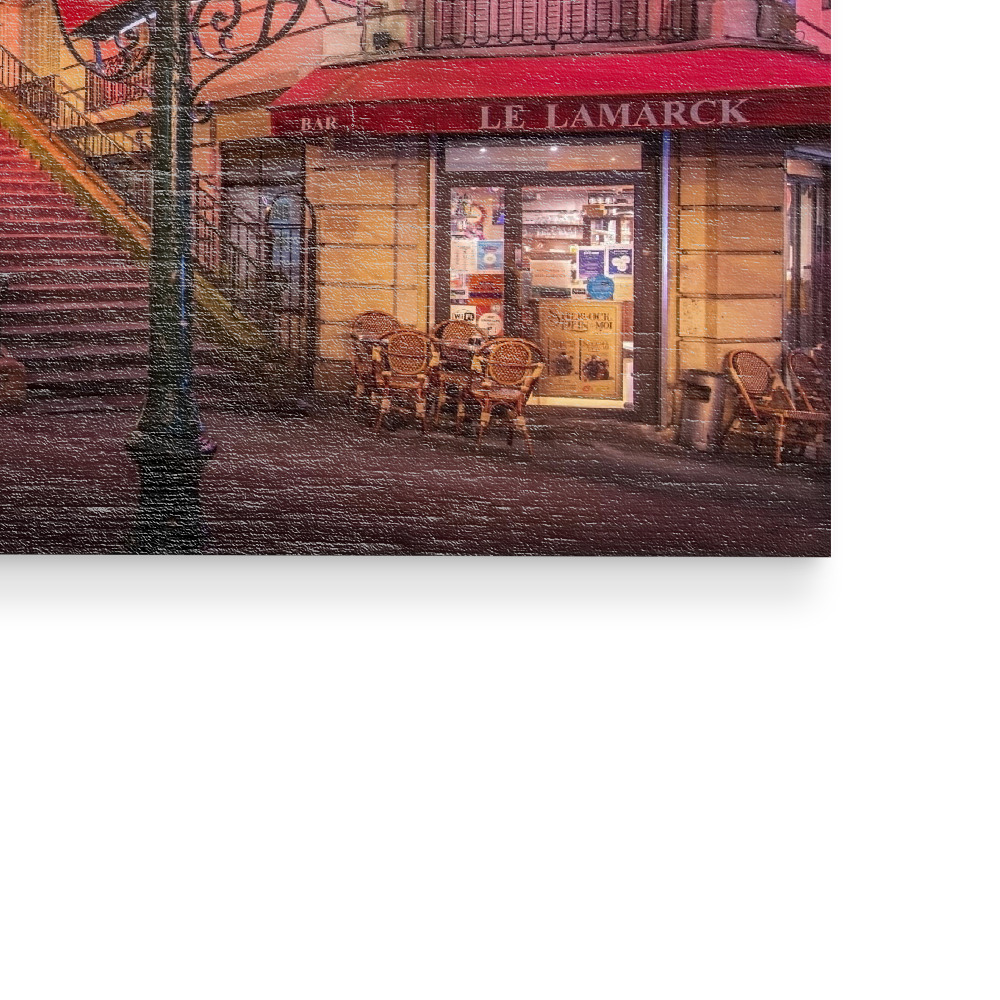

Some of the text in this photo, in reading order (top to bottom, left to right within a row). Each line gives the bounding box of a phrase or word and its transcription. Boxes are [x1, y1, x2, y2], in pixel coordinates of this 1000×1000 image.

[301, 116, 338, 132] BAR
[479, 98, 751, 130] LE LAMARCK
